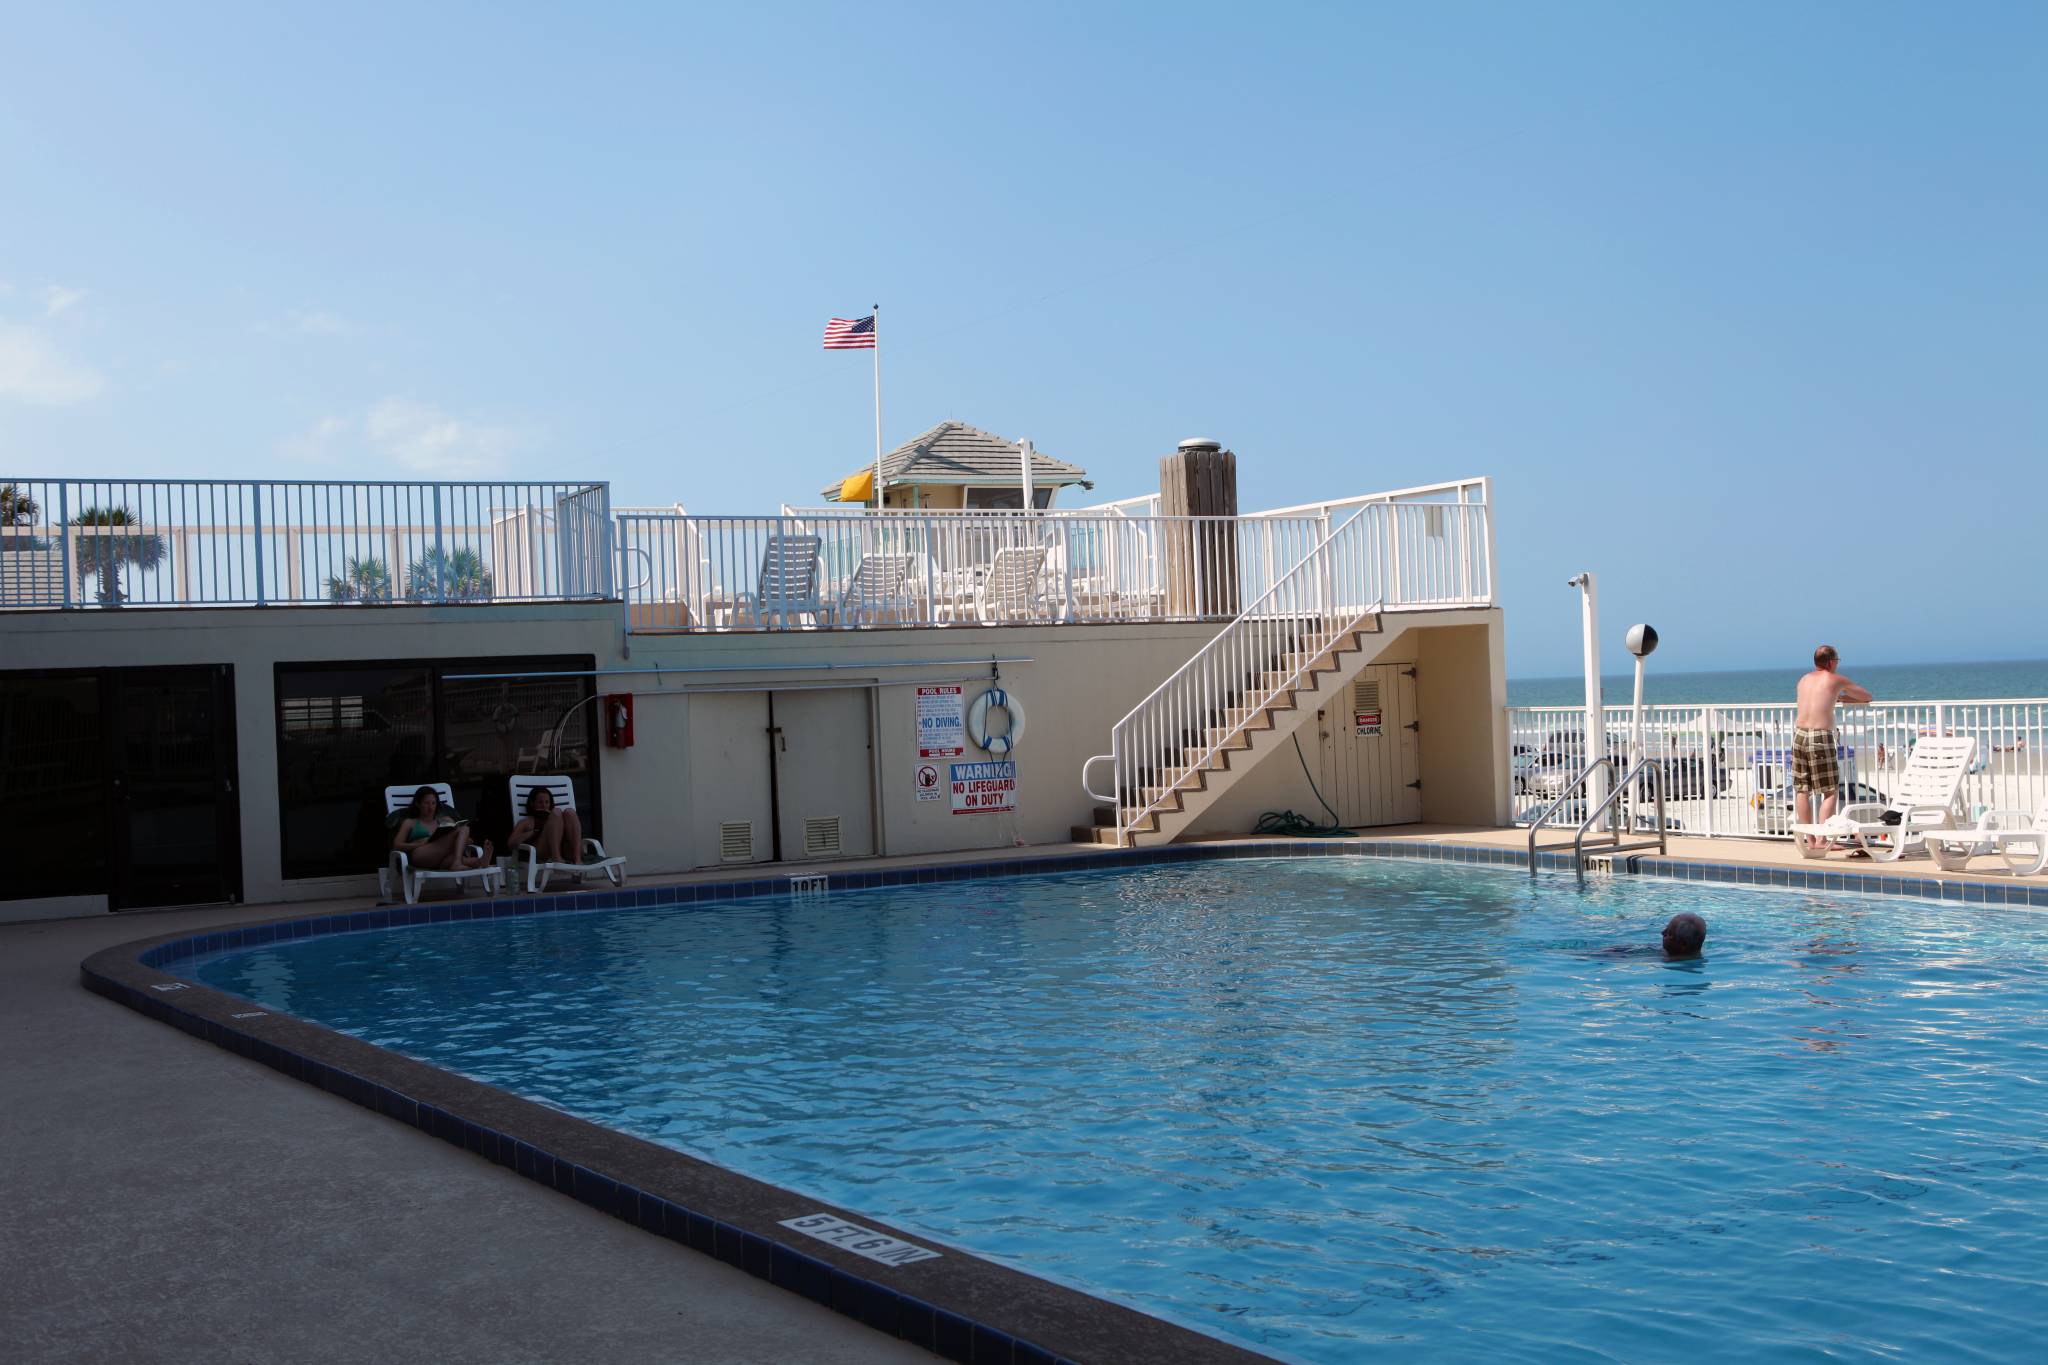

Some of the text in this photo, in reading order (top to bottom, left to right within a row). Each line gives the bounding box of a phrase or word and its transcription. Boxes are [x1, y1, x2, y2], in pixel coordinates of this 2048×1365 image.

[940, 687, 957, 695] RULES
[922, 715, 962, 728] NO DIVING.
[1356, 726, 1381, 735] CHLORINE
[954, 762, 1011, 780] WARNING
[952, 779, 1015, 794] NO LIFEGUARD
[965, 793, 1003, 806] ON DUTY
[794, 1216, 835, 1228] 5
[852, 1238, 893, 1250] 6
[875, 1247, 930, 1263] IN
